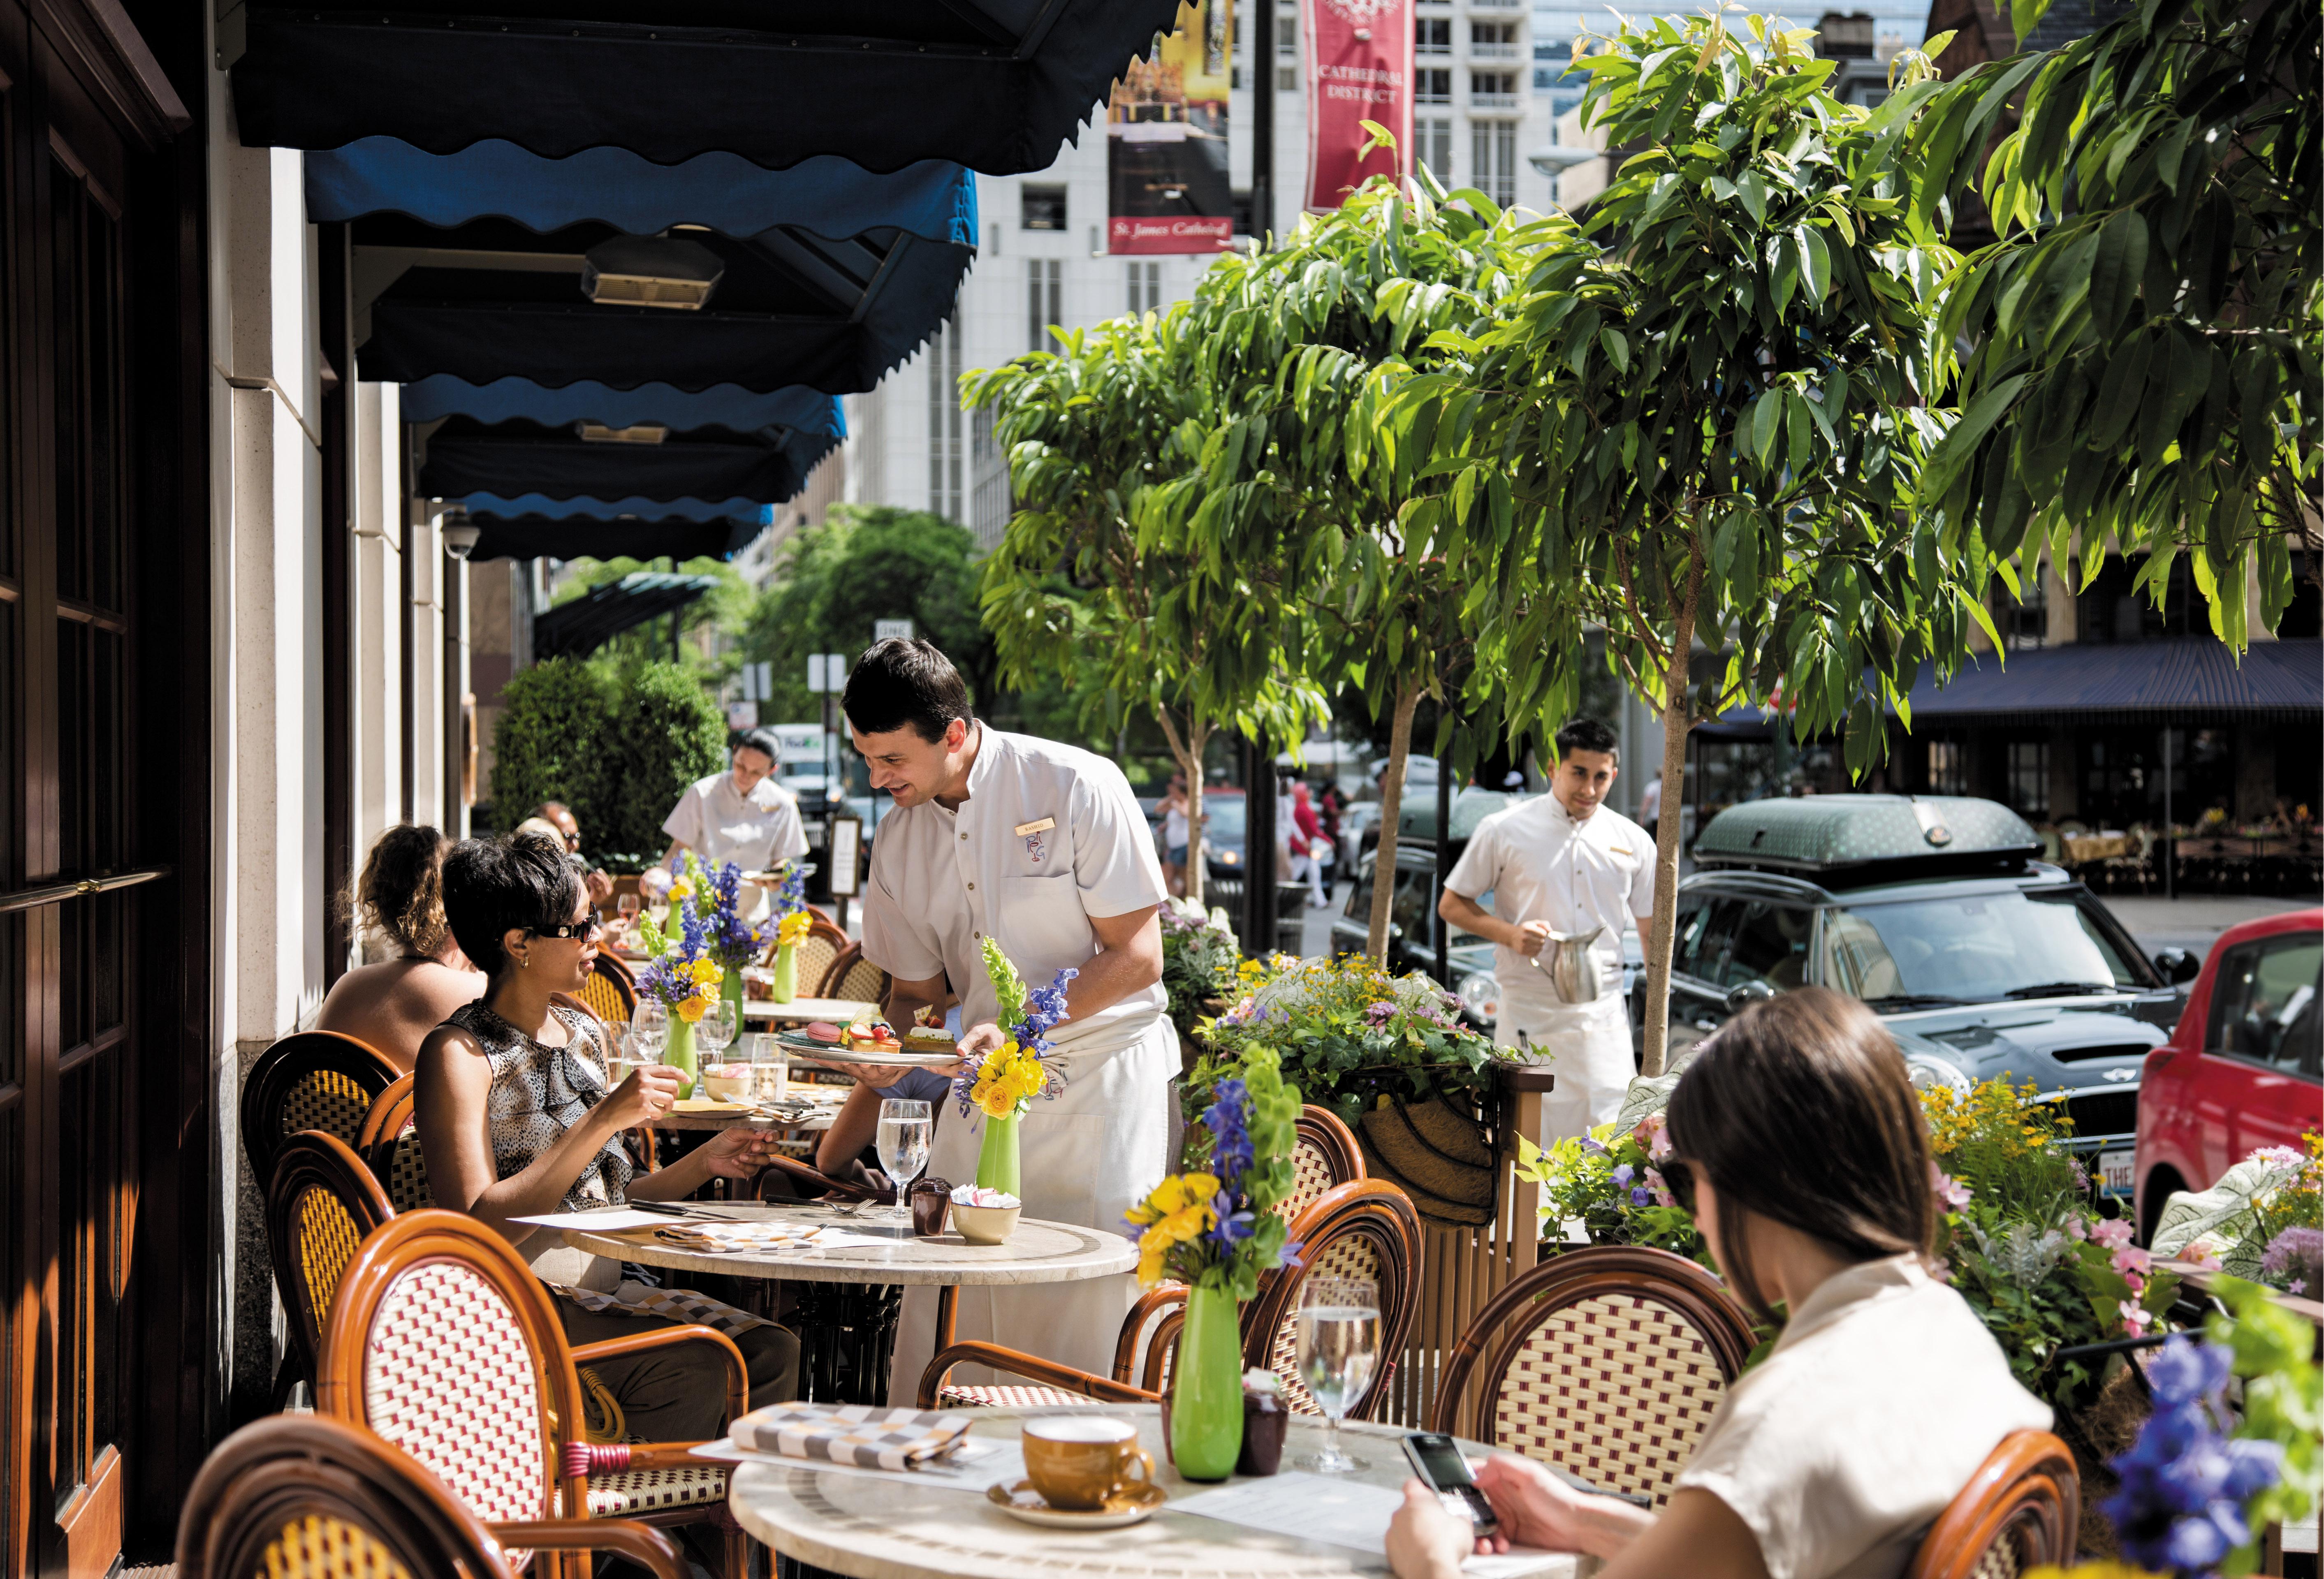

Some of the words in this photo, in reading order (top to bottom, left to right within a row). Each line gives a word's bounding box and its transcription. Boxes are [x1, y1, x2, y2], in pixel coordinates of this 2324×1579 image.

[1318, 65, 1403, 87] CATHEDRAL
[1328, 84, 1396, 104] DISTRICT
[1131, 223, 1169, 239] James
